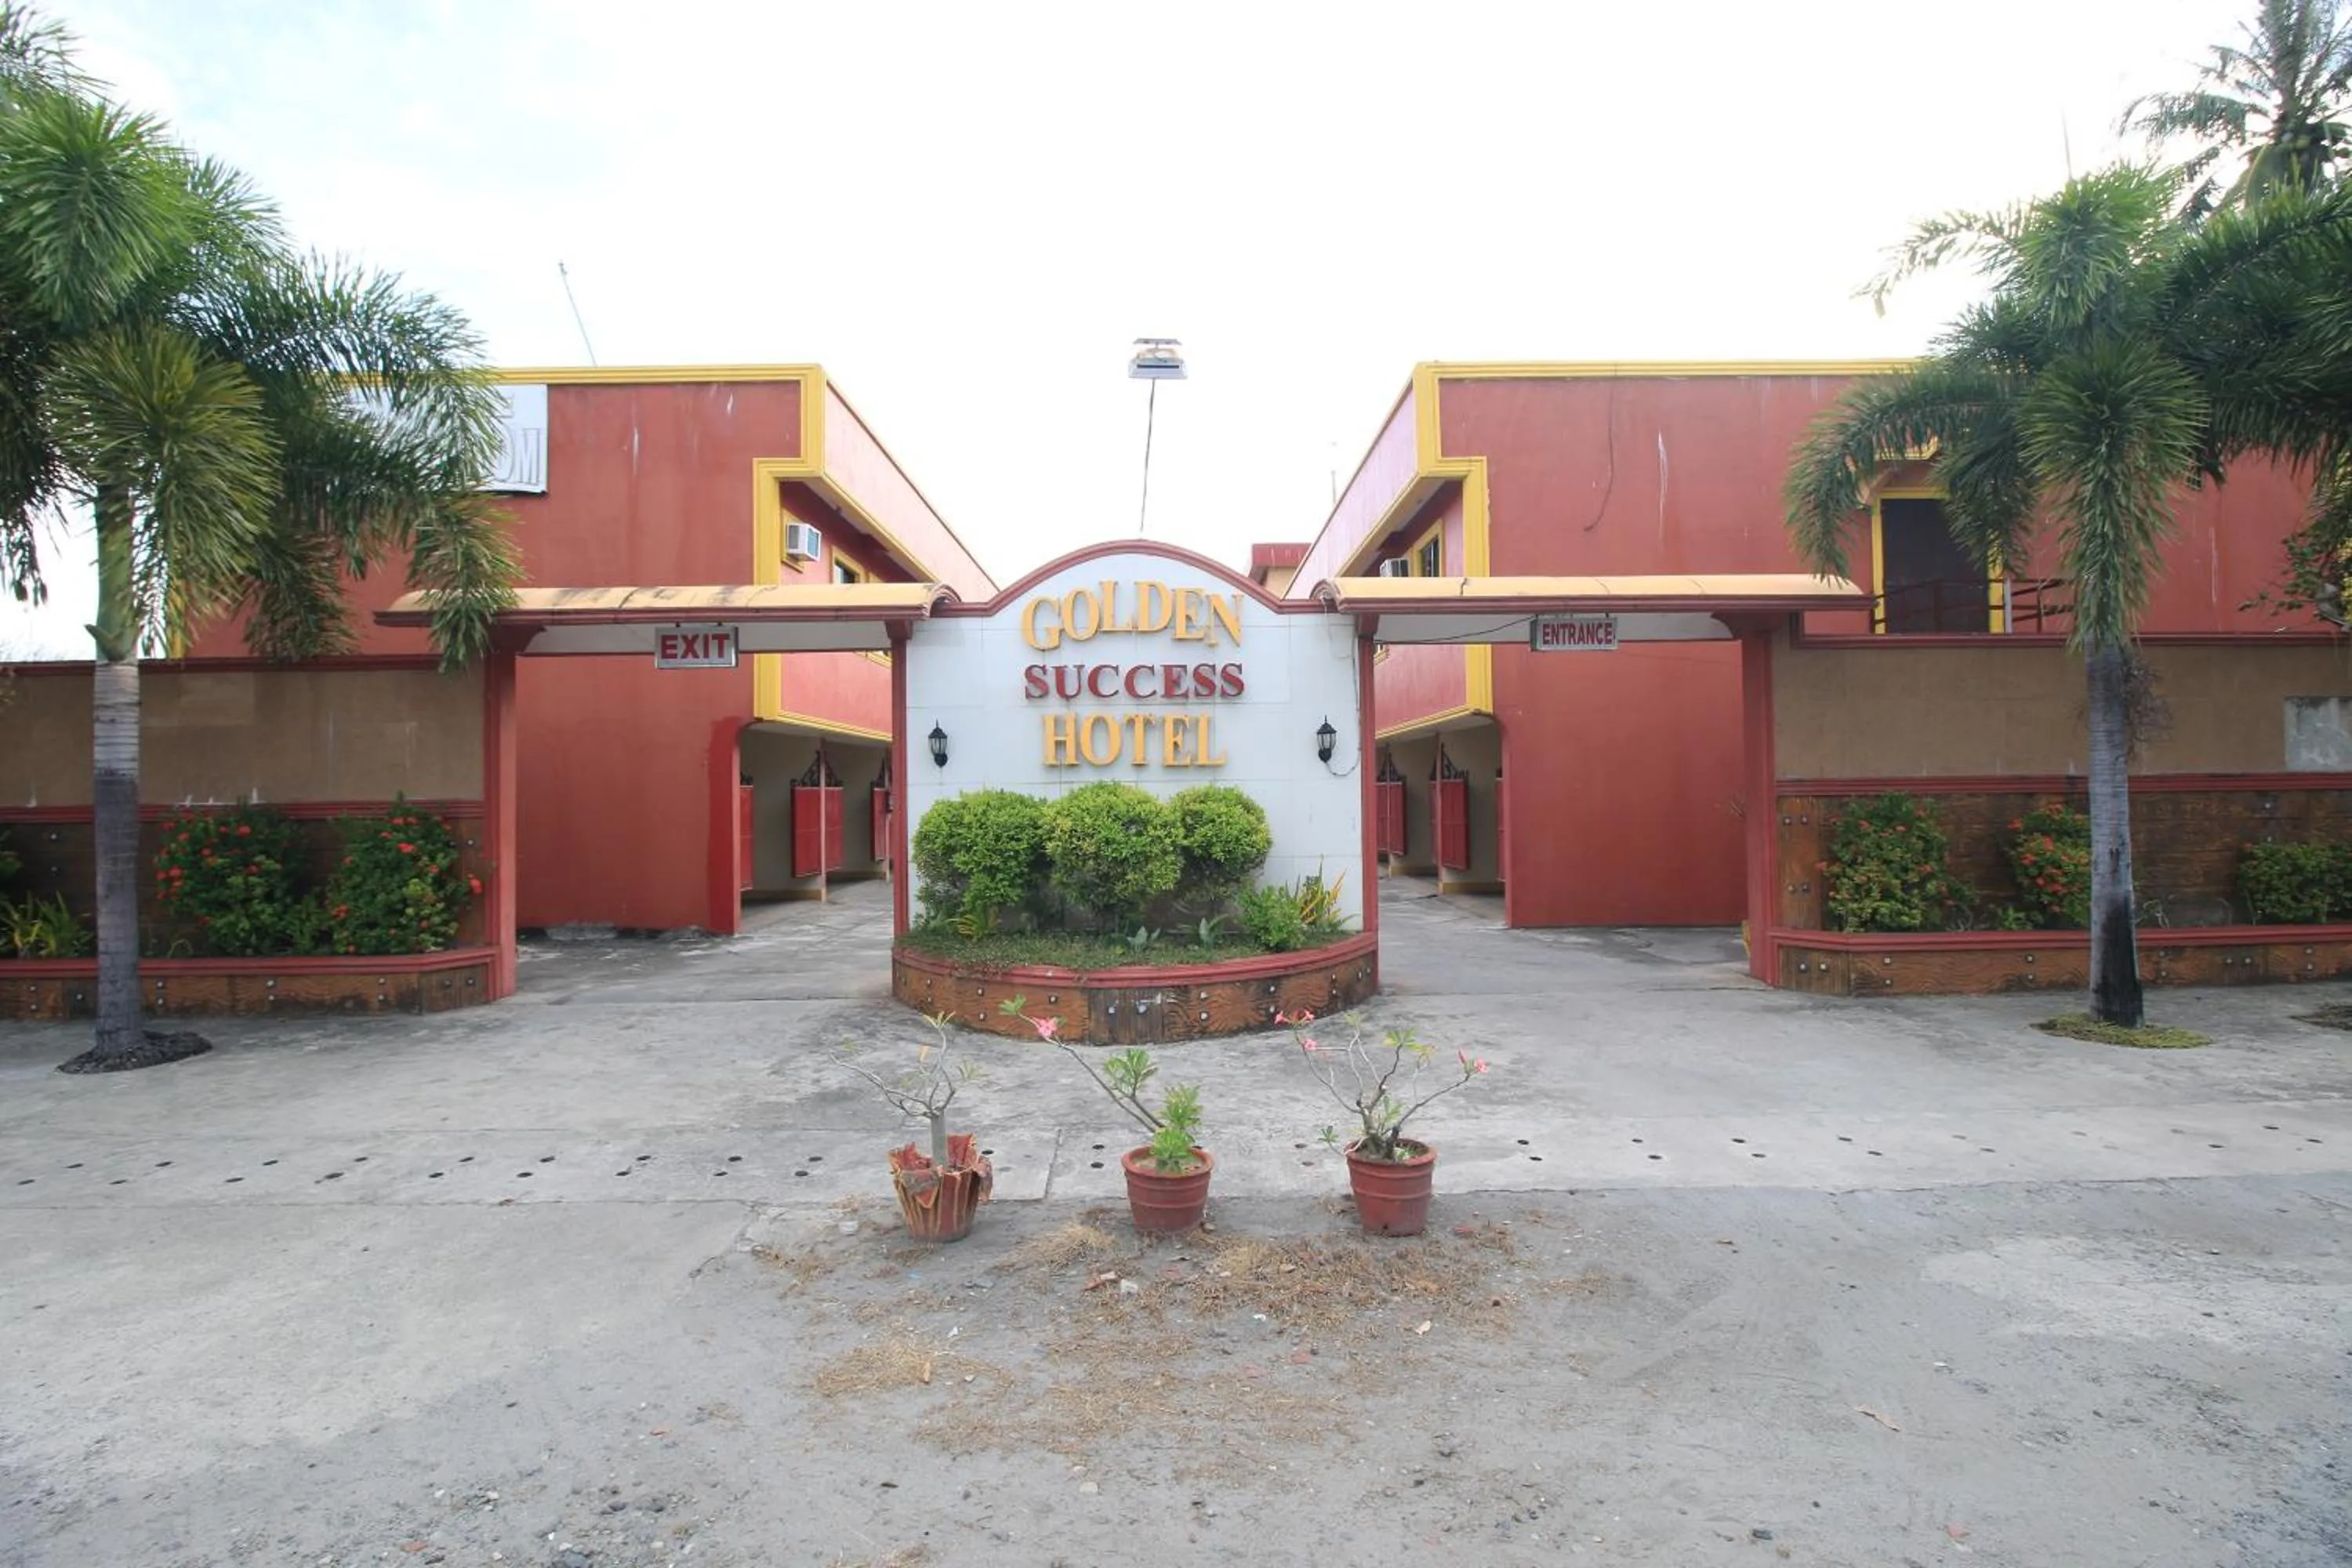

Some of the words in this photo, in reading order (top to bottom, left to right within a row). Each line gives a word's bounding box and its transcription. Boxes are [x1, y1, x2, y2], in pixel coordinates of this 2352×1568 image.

[1022, 580, 1244, 651] GOLDEN
[1542, 622, 1613, 644] ENTRANCE
[661, 633, 730, 659] EXIT
[1025, 663, 1245, 699] SUCCESS
[1043, 712, 1227, 767] HOTEL
